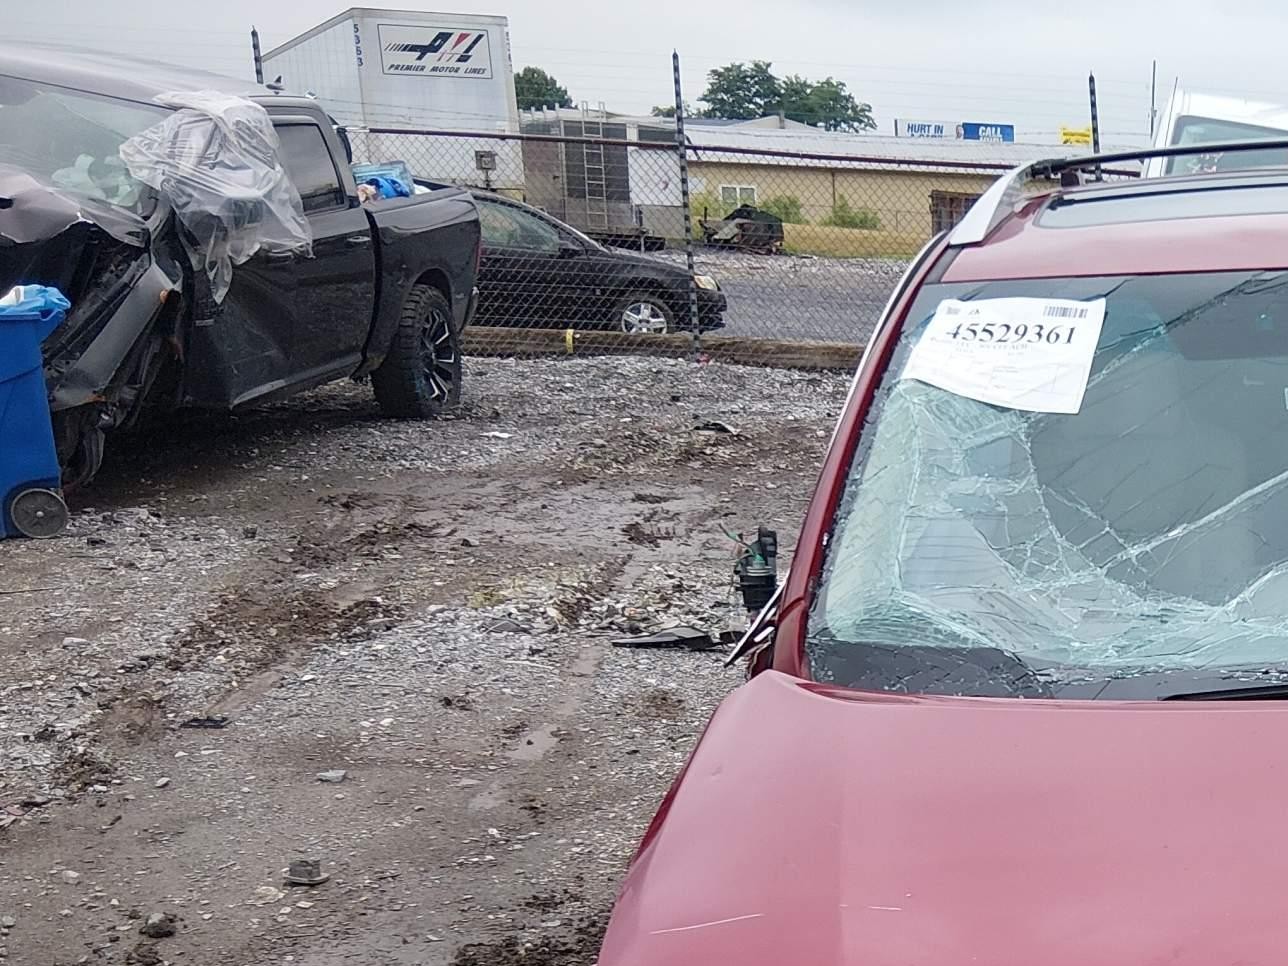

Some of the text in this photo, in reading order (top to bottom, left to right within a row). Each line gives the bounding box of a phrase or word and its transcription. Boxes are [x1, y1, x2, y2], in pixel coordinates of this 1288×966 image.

[388, 63, 487, 75] PREMIER MOTOR LINES
[907, 122, 944, 135] HURT IN
[978, 125, 1002, 138] CALL
[945, 322, 1077, 345] 45529361
